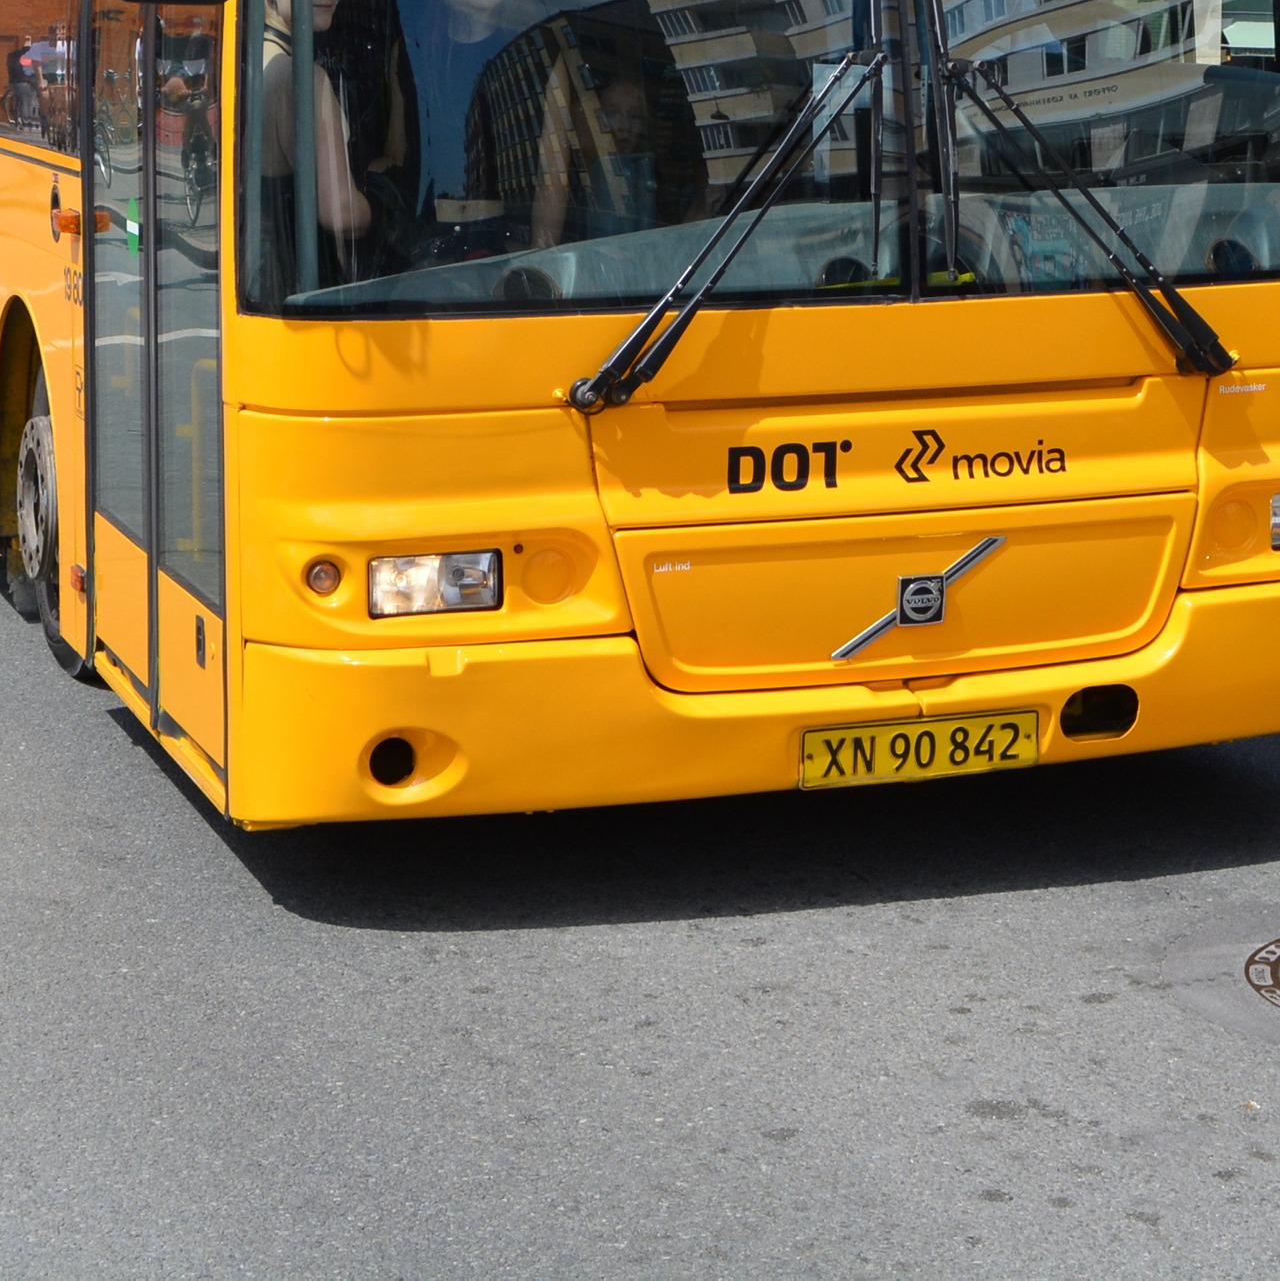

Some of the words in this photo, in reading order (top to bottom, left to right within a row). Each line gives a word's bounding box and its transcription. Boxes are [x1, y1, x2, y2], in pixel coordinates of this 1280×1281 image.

[1219, 383, 1266, 394] Rudevasker
[728, 439, 852, 494] DOT
[952, 439, 1067, 480] movia
[653, 562, 672, 572] Luft
[675, 560, 690, 571] ind
[821, 735, 876, 778] XN
[890, 730, 936, 773] 90
[948, 722, 1020, 766] 842
